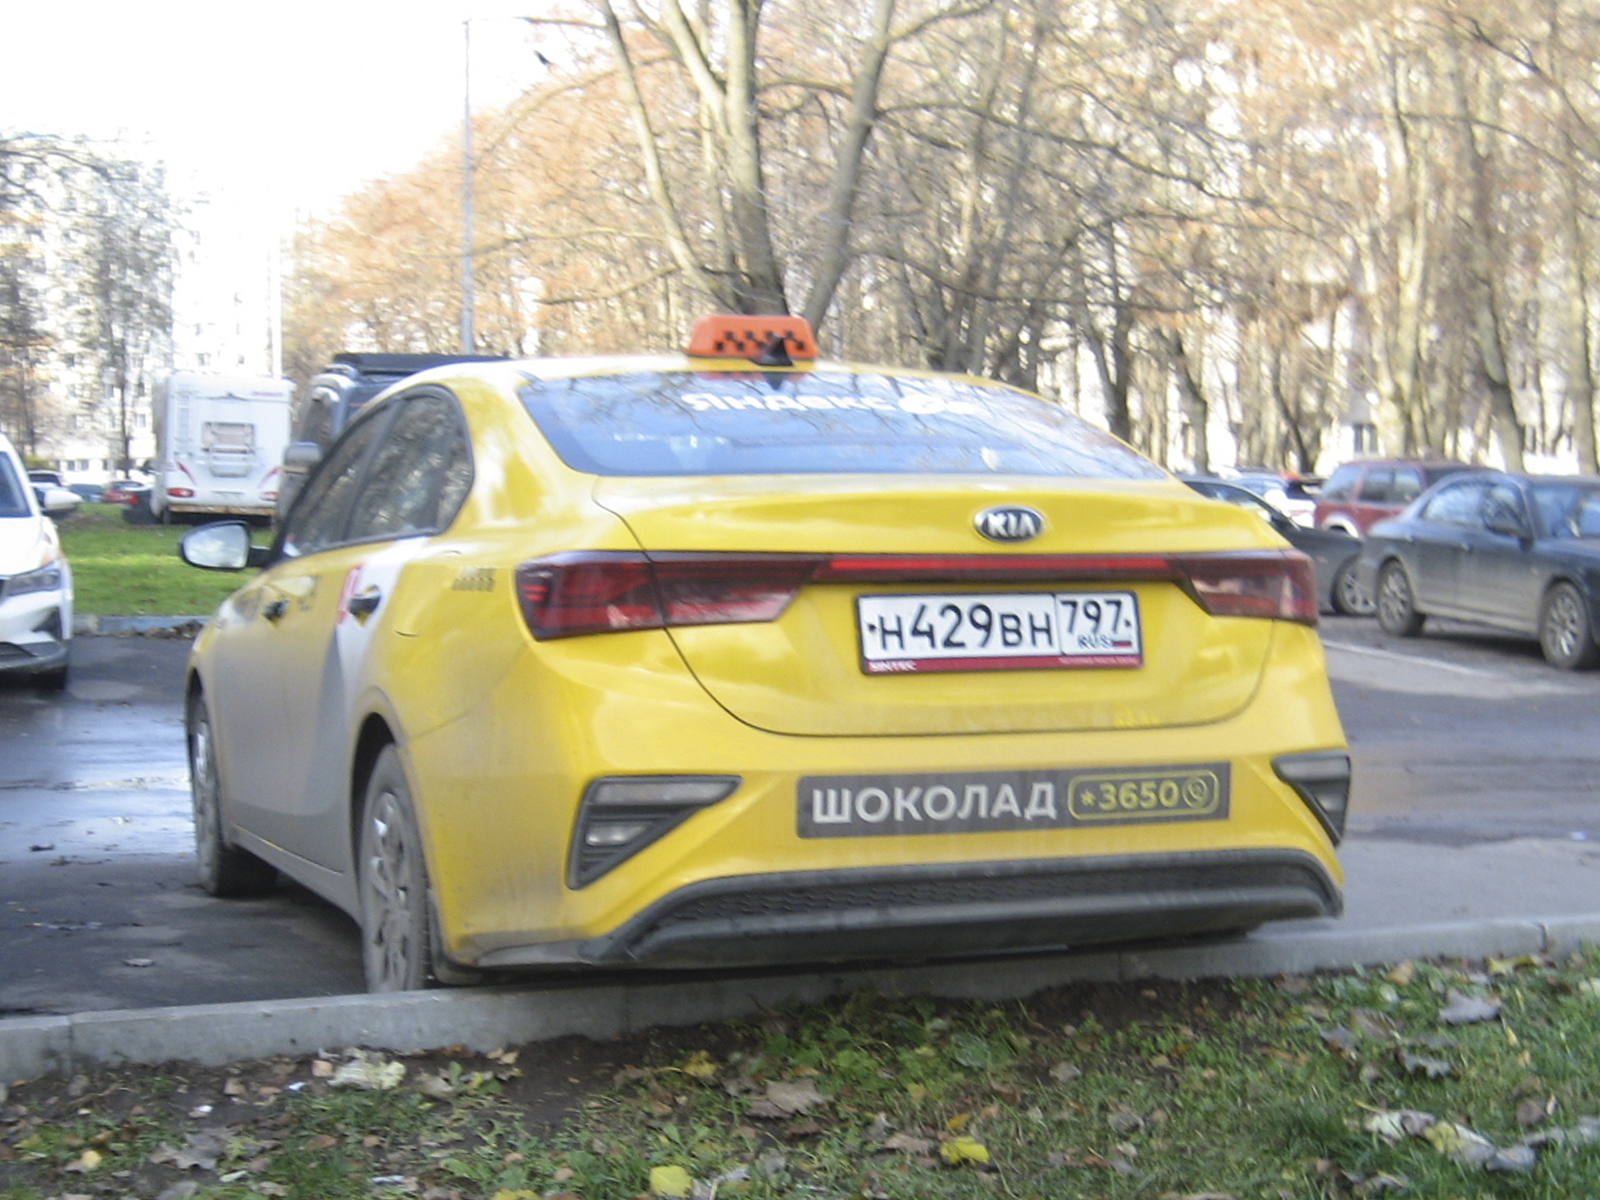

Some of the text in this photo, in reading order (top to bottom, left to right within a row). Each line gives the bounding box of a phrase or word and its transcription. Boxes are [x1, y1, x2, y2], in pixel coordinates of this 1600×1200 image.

[986, 511, 1038, 538] KIA
[878, 600, 1123, 650] Н429ВН 797
[812, 781, 1057, 824] ШОКОЛАД
